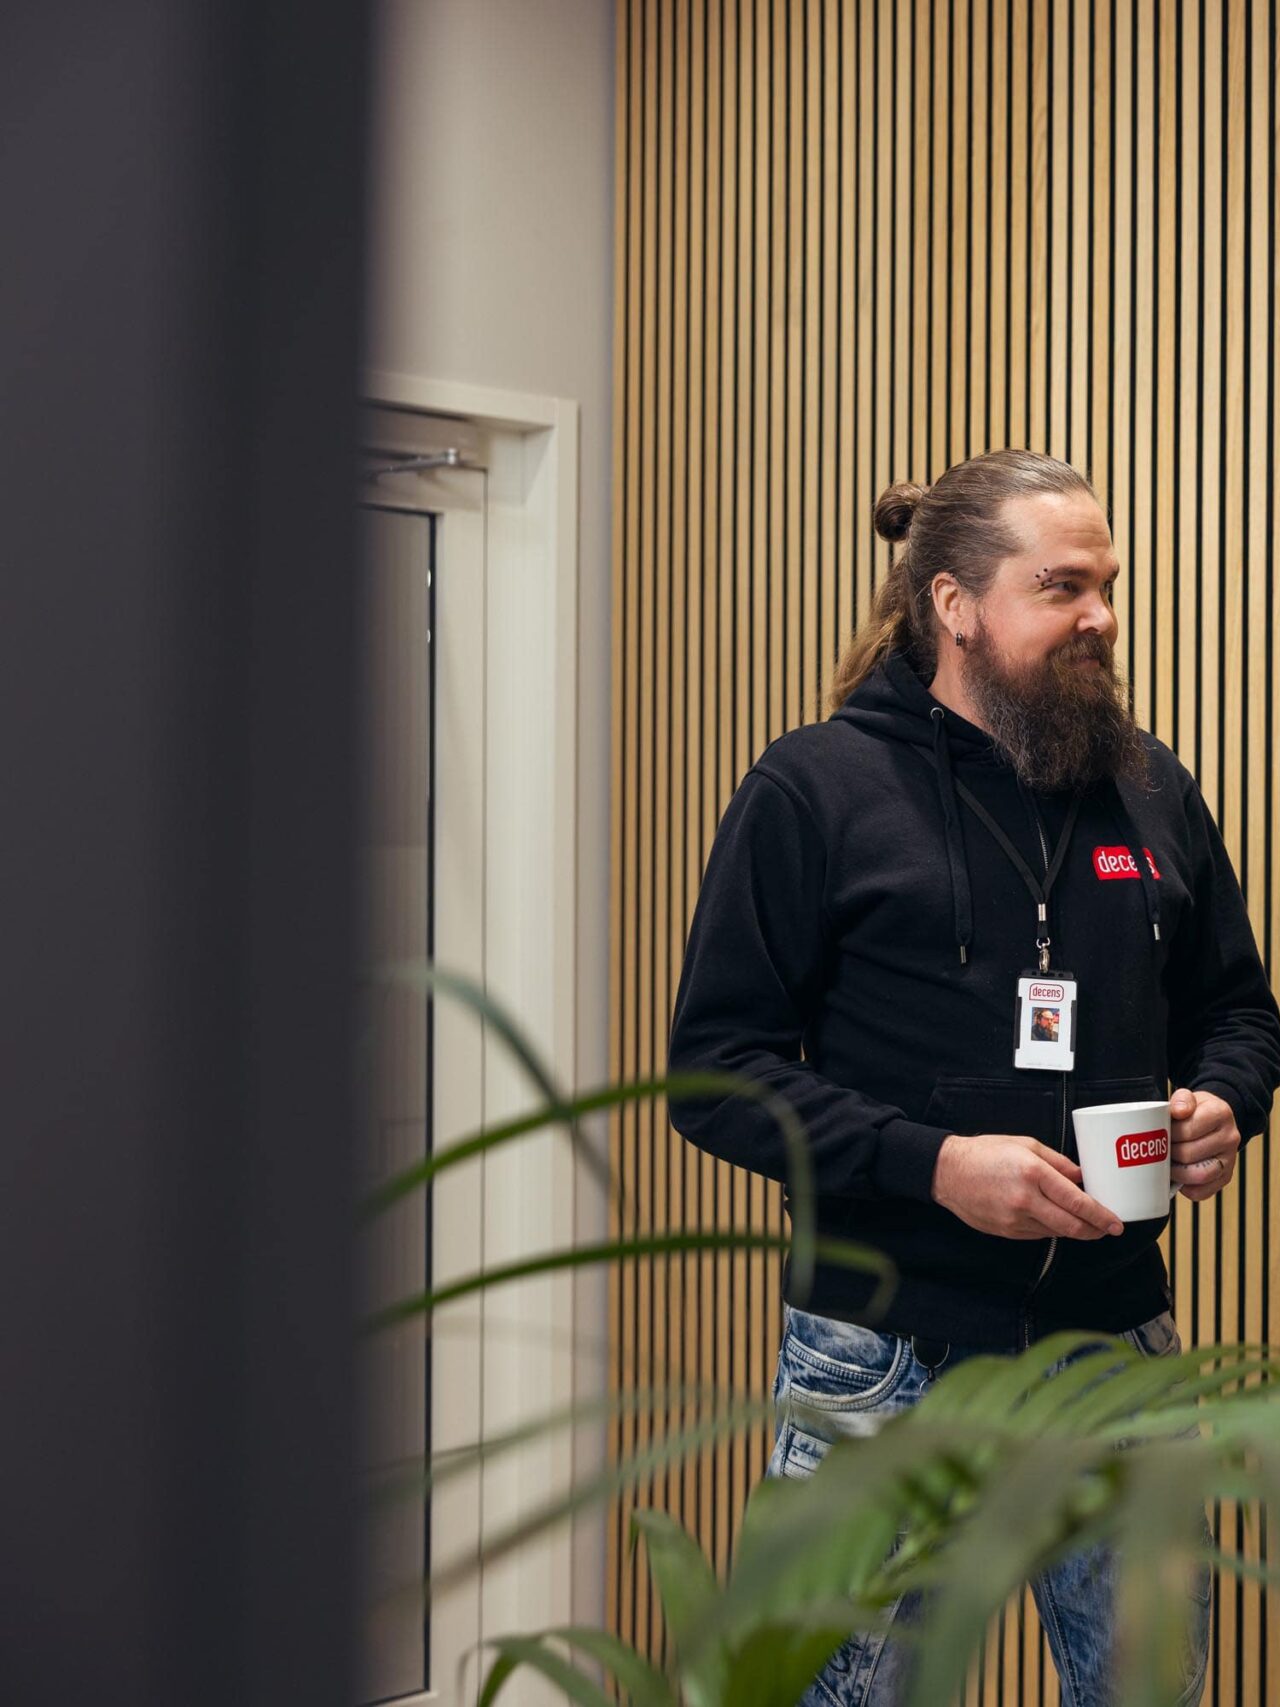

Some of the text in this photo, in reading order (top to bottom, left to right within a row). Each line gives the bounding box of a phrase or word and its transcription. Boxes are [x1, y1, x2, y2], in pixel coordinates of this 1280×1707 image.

[1097, 850, 1156, 875] dece
[1032, 986, 1061, 998] decens
[1120, 1137, 1168, 1161] decens
